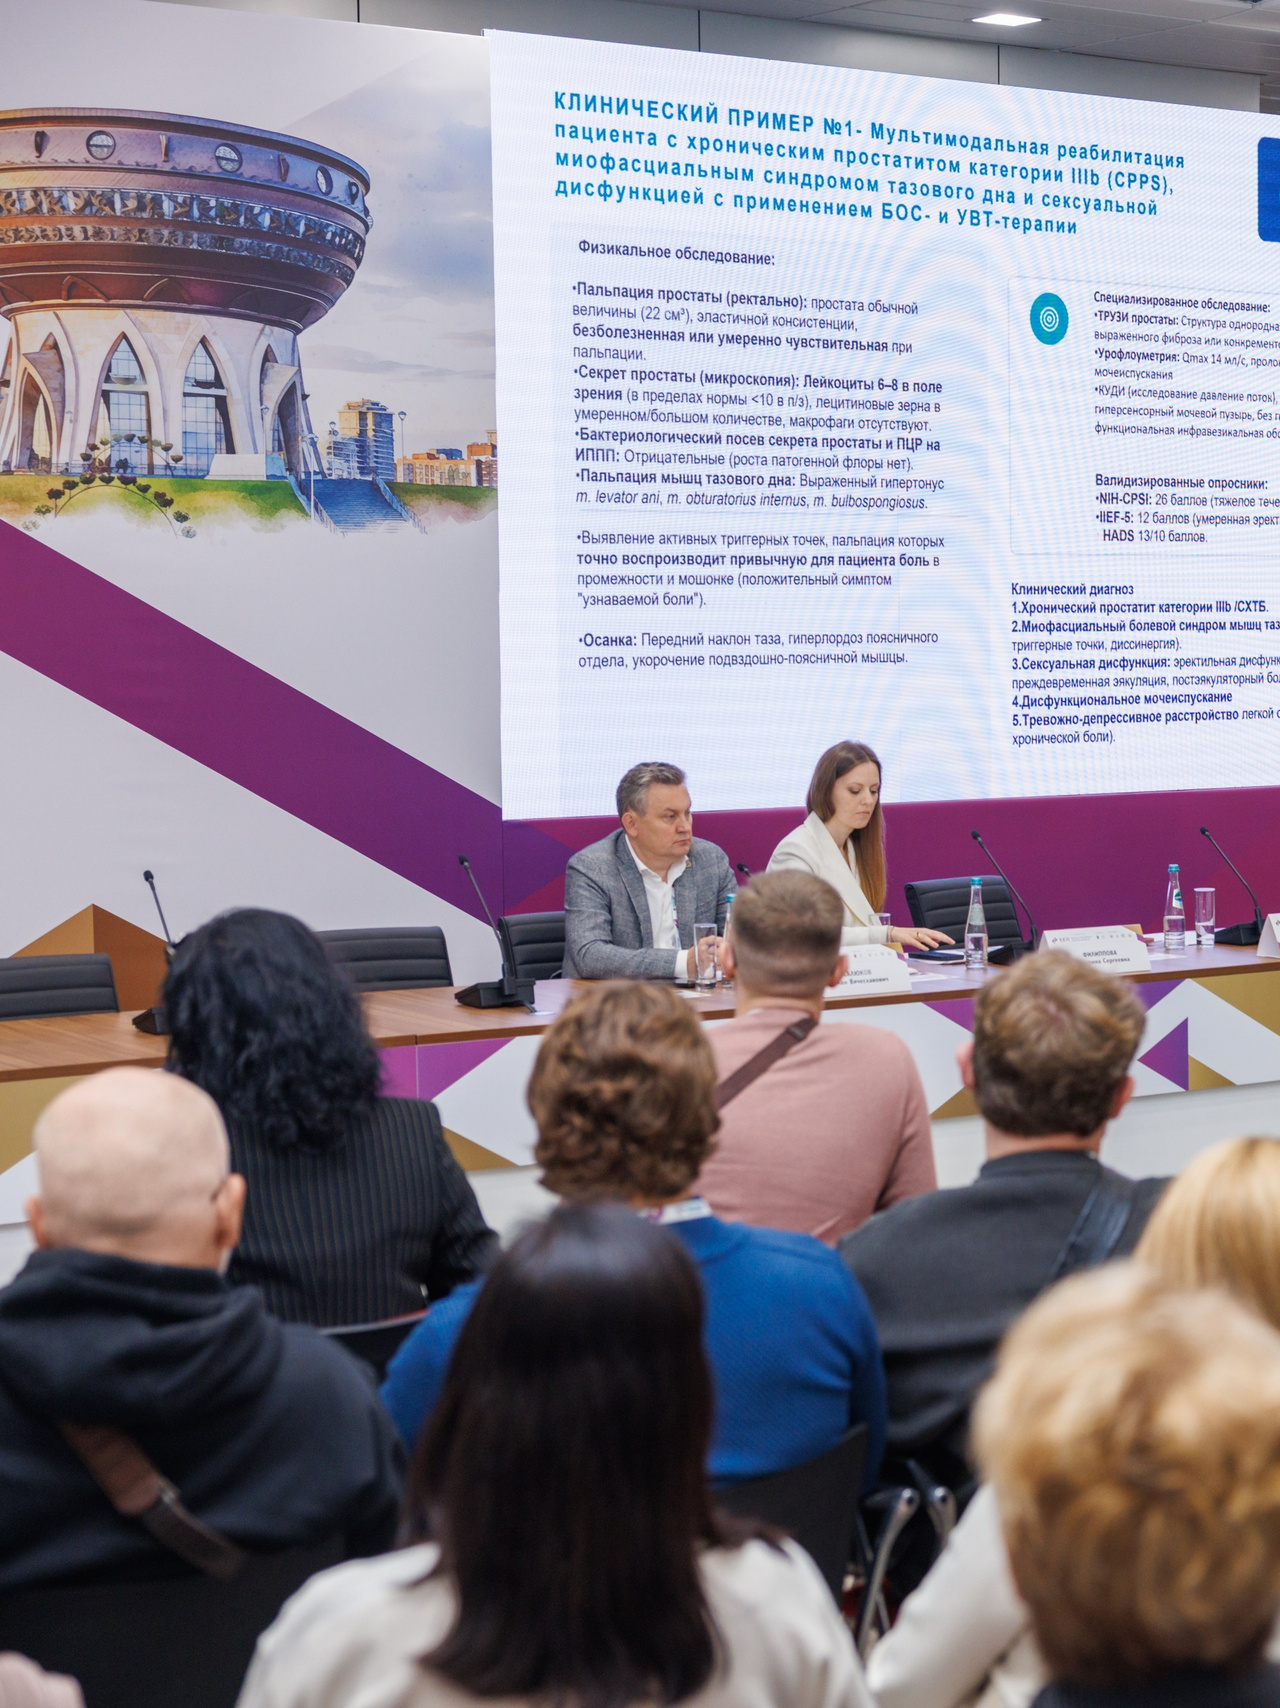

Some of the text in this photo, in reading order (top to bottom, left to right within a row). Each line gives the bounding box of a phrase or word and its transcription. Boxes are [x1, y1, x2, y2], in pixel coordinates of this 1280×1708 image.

[554, 91, 718, 124] КЛИНИЧЕСКИЙ
[728, 108, 814, 132] ПРИМЕР
[870, 121, 1049, 155] Мультимодальная
[1057, 144, 1184, 169] реабилитация
[555, 123, 657, 146] пациента
[667, 133, 677, 148] с
[687, 136, 824, 161] хроническим
[833, 148, 960, 173] простатитом
[969, 162, 1063, 184] категории
[1107, 171, 1173, 195] (CPPS),
[555, 152, 1157, 215] миофасциальным синдромом тазового дна и сексуальной
[554, 180, 1077, 235] дисфункцией с применением БОС- и УВТ-терапии
[578, 239, 775, 266] Физикальное обследование:
[572, 305, 637, 319] величины
[641, 306, 661, 322] (22
[697, 311, 769, 326] эластичной
[772, 316, 858, 332] консистенции,
[573, 322, 913, 355] безболезненная или умеренно чувствительная при
[573, 346, 646, 362] пальпации.
[574, 388, 623, 402] зрения
[626, 389, 639, 404] (в
[642, 390, 703, 404] пределах
[706, 393, 747, 407] нормы
[751, 392, 774, 407] <10
[777, 396, 784, 407] в
[816, 397, 895, 412] лецитиновые
[898, 401, 931, 414] зерна
[934, 402, 941, 413] в
[712, 414, 786, 428] количестве,
[789, 415, 855, 431] макрофаги
[857, 418, 931, 434] отсутствуют.
[575, 447, 914, 472] ИППП: Отрицательные (роста патогенной флоры нет).
[1095, 473, 1205, 489] Валидизированные
[595, 490, 639, 504] levator
[685, 491, 757, 507] obturatorius
[577, 553, 940, 568] точно воспроизводит привычную для пациента боль в
[577, 572, 893, 588] промежности и мошонке (положительный симптом
[1011, 582, 1134, 597] Клинический диагноз
[1099, 603, 1156, 616] простатит
[1158, 603, 1213, 615] категории
[1128, 618, 1176, 632] болевой
[1179, 621, 1227, 633] синдром
[1229, 621, 1262, 632] мышц
[1011, 640, 1073, 654] триггерные
[578, 650, 908, 670] отдела, укорочение подвздошно-поясничной мышцы.
[1174, 657, 1237, 670] эректильная
[1144, 692, 1232, 705] мочеиспускание
[1164, 709, 1239, 724] расстройство
[1242, 707, 1274, 720] легкой
[1012, 731, 1080, 747] хронической
